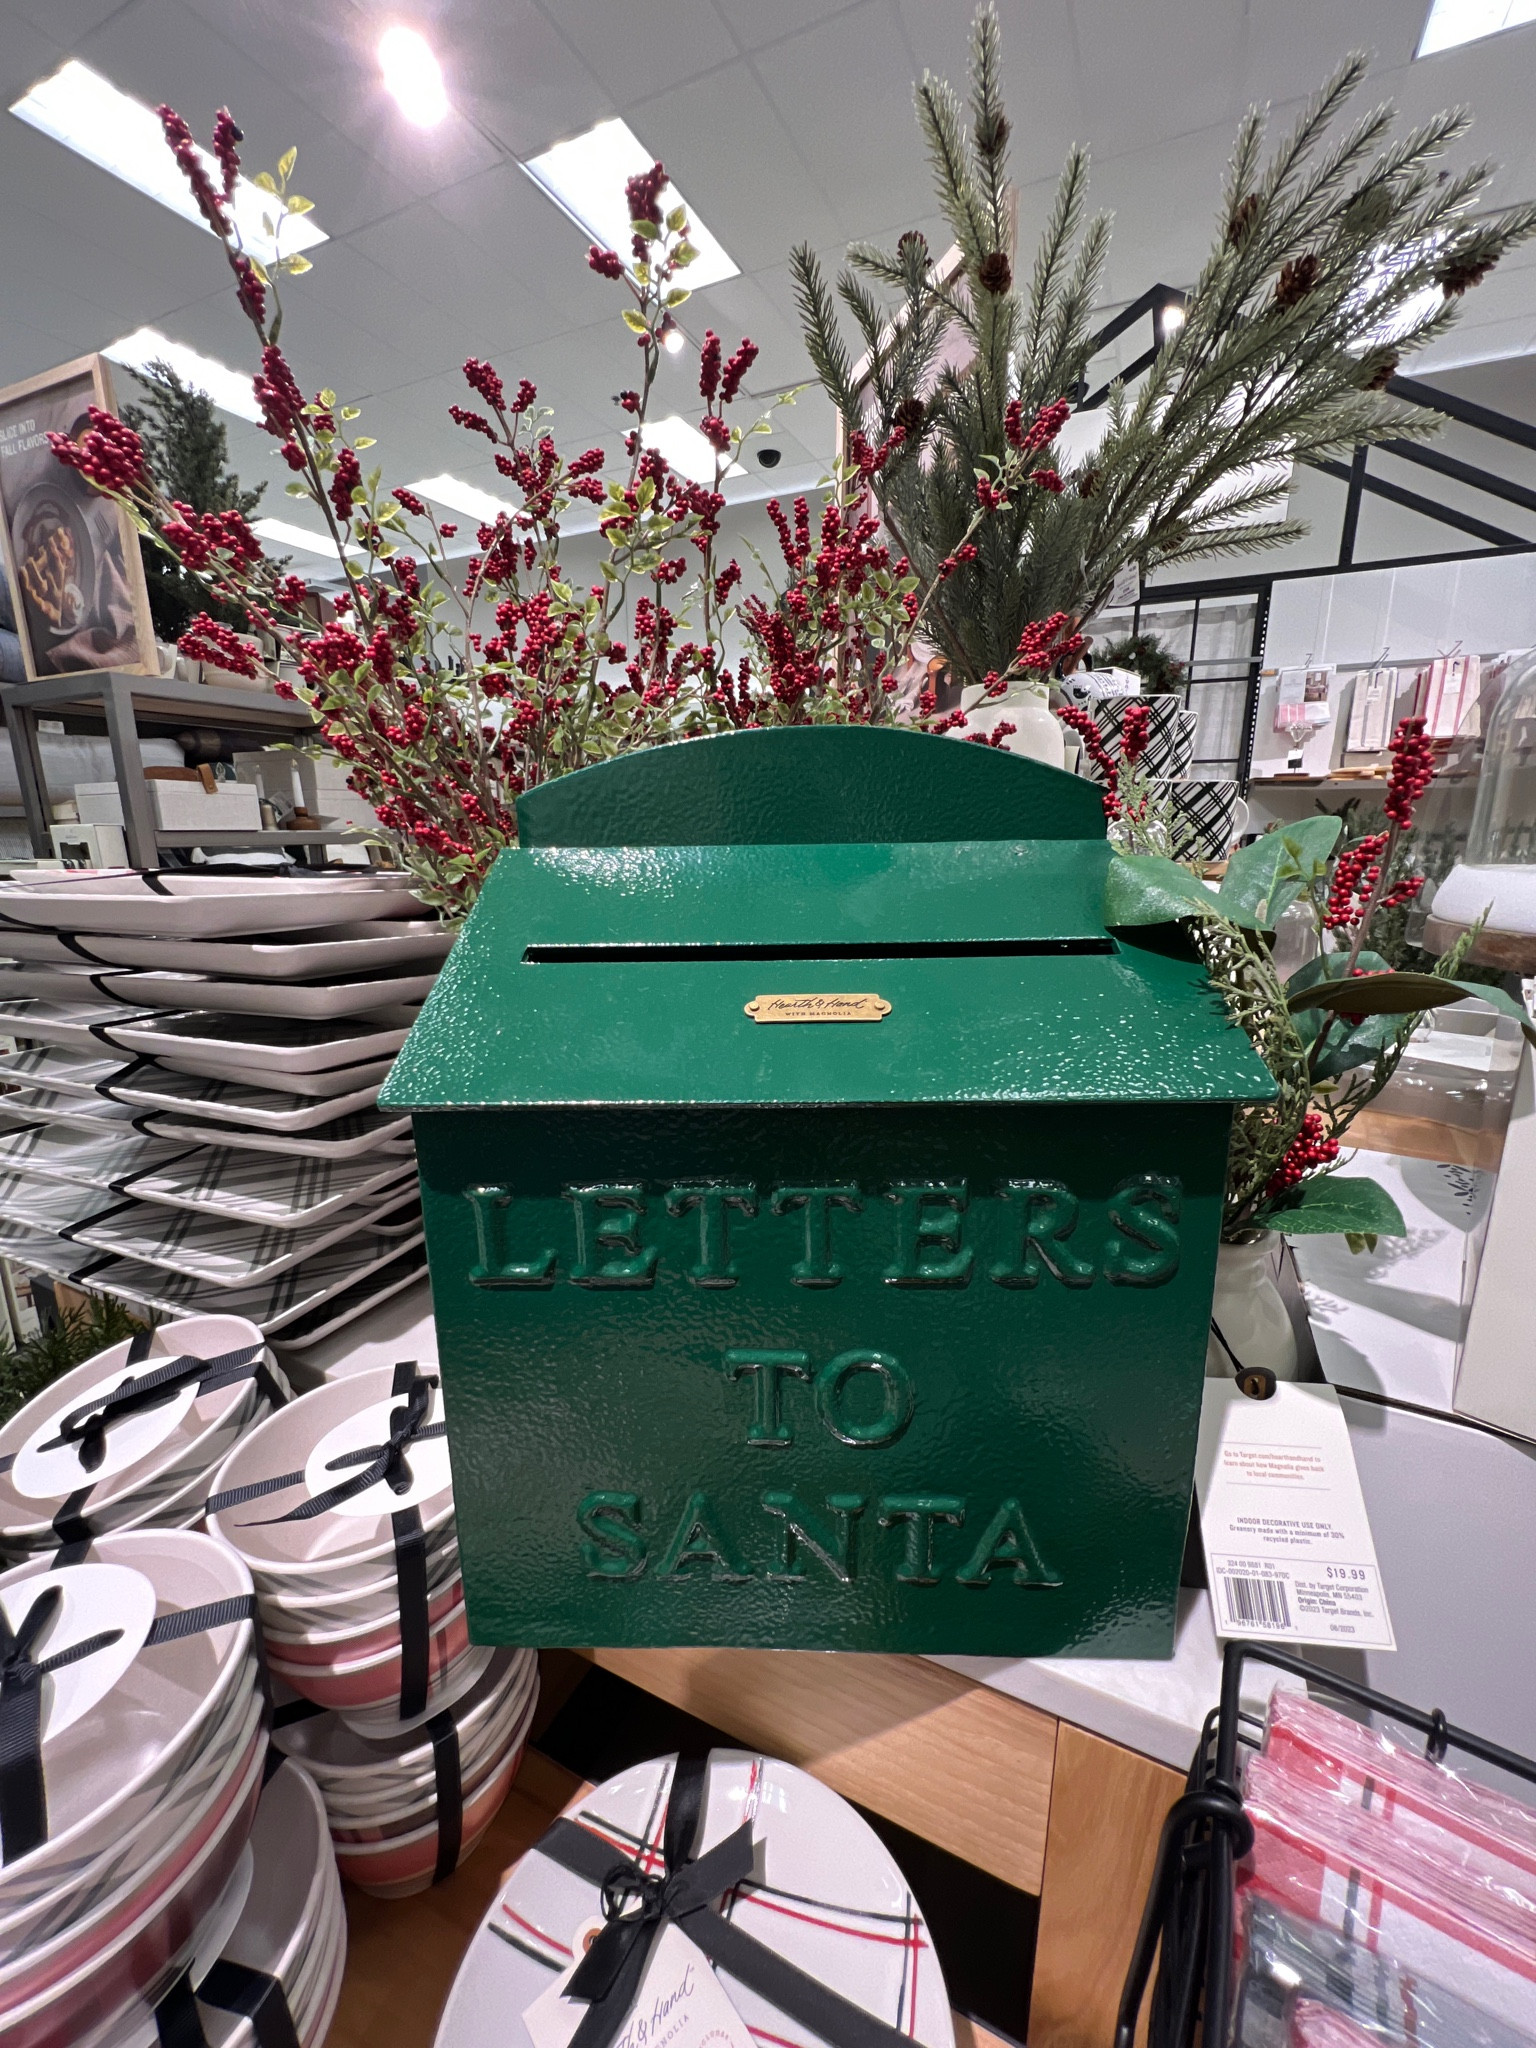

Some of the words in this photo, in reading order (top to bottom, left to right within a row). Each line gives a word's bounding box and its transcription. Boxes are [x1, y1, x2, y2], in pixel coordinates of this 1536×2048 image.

[18, 419, 36, 435] INTO
[1, 444, 18, 458] FALL
[767, 997, 817, 1011] Hearth
[815, 998, 824, 1009] &
[824, 998, 867, 1009] Hand
[463, 1173, 1184, 1290] LETTERS
[722, 1347, 915, 1449] TO
[1268, 1462, 1294, 1470] Magnolia
[1237, 1517, 1261, 1525] INDOOR
[1262, 1518, 1300, 1528] DECORATIVE
[1302, 1521, 1314, 1529] USE
[1229, 1524, 1256, 1533] Greenery
[1275, 1527, 1288, 1535] with
[1294, 1529, 1322, 1537] minimum
[575, 1490, 1065, 1588] SANTA
[1263, 1535, 1289, 1544] recycled
[1326, 1566, 1366, 1580] $19.99
[1317, 1582, 1335, 1591] Target
[1335, 1583, 1369, 1593] Corporation
[1332, 1591, 1343, 1599] MN
[1318, 1598, 1336, 1606] China
[1321, 1606, 1339, 1616] Target
[637, 2018, 648, 2046] &
[651, 1963, 695, 2036] Hand
